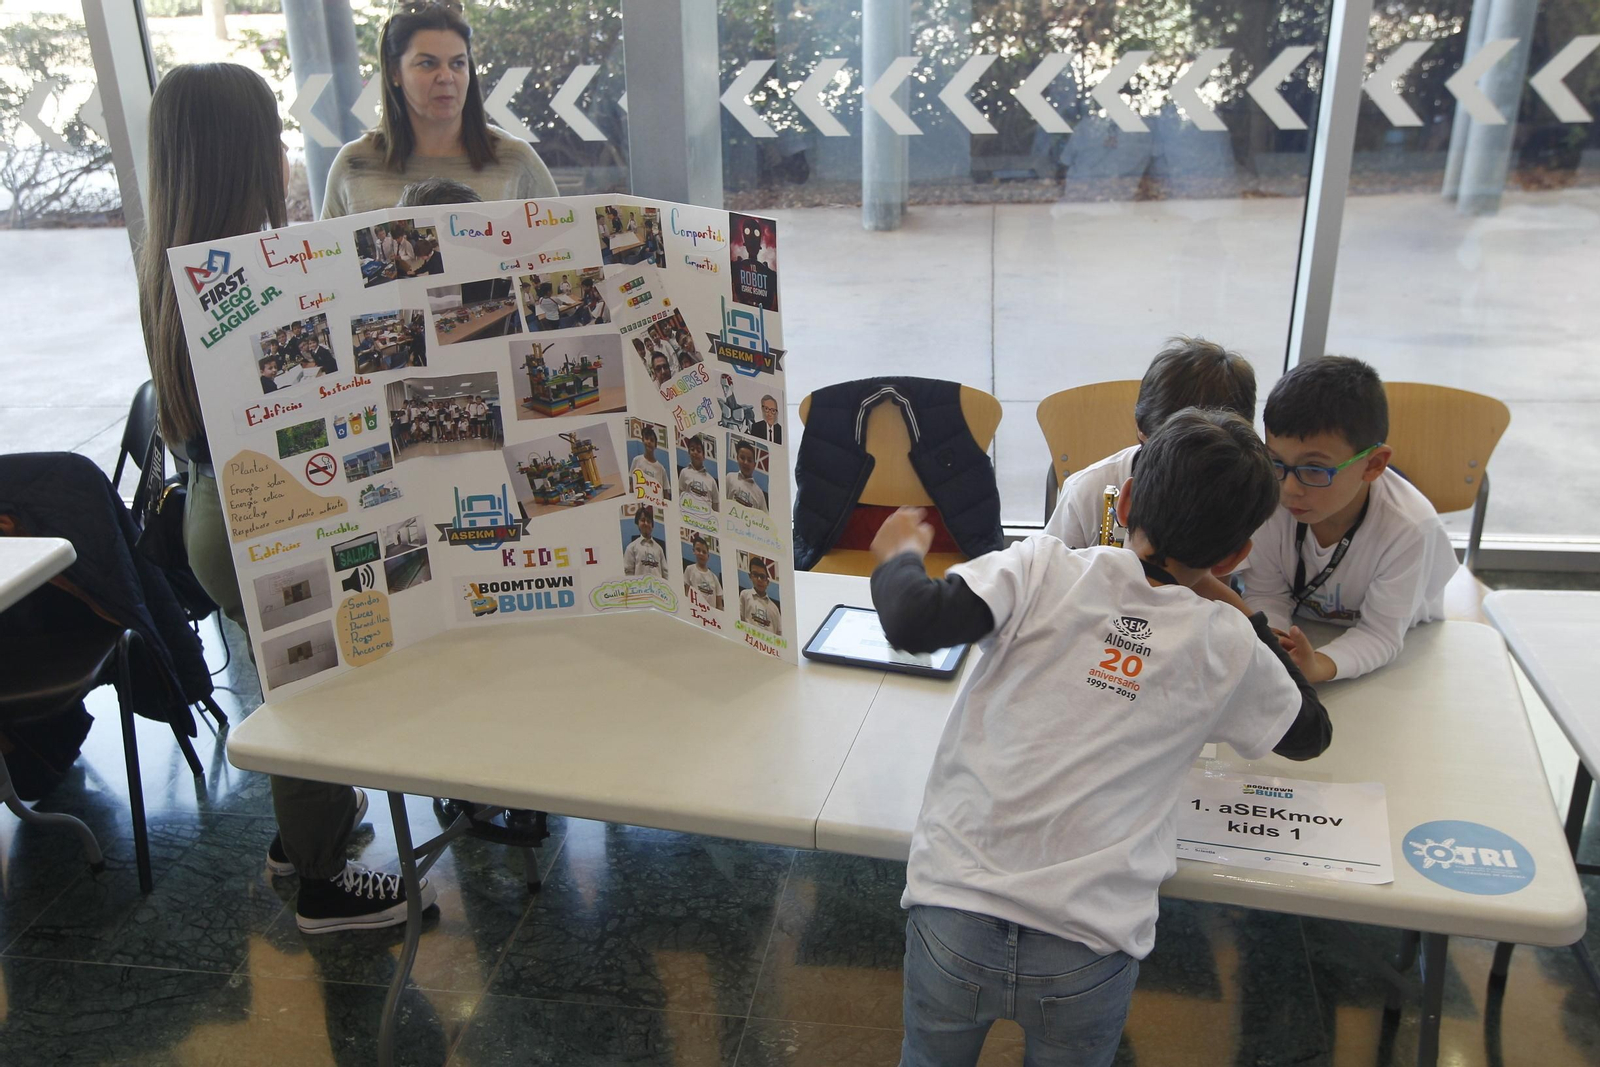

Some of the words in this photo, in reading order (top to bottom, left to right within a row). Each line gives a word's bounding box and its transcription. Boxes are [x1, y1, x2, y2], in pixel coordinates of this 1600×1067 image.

[450, 214, 493, 237] Cread
[501, 230, 512, 245] y
[524, 201, 575, 228] Probad
[260, 233, 342, 274] Explorad
[199, 267, 246, 312] FIRST
[740, 270, 767, 289] ROBOT
[211, 285, 251, 322] LEGO
[200, 300, 260, 349] LEAGUE
[260, 286, 283, 307] JR.
[246, 401, 303, 427] Edificios
[231, 459, 269, 476] Plantas
[248, 541, 302, 563] Edificios
[339, 544, 375, 567] SALIDA
[502, 547, 570, 568] KIDS
[585, 548, 598, 565] 1
[479, 576, 573, 594] BOOMTOWN
[498, 590, 575, 613] BUILD
[350, 610, 373, 620] Luces
[1122, 618, 1145, 633] SEK
[745, 633, 780, 657] MANUEL
[1104, 632, 1151, 657] Alborán
[1099, 648, 1143, 677] 20
[1089, 668, 1140, 692] aniversario
[1246, 784, 1294, 793] BOOMTOWN
[1255, 789, 1294, 799] BUILD
[1191, 799, 1210, 812] 1.
[1219, 803, 1343, 827] aSEKmov
[1228, 821, 1280, 837] kids
[1290, 828, 1300, 840] 1
